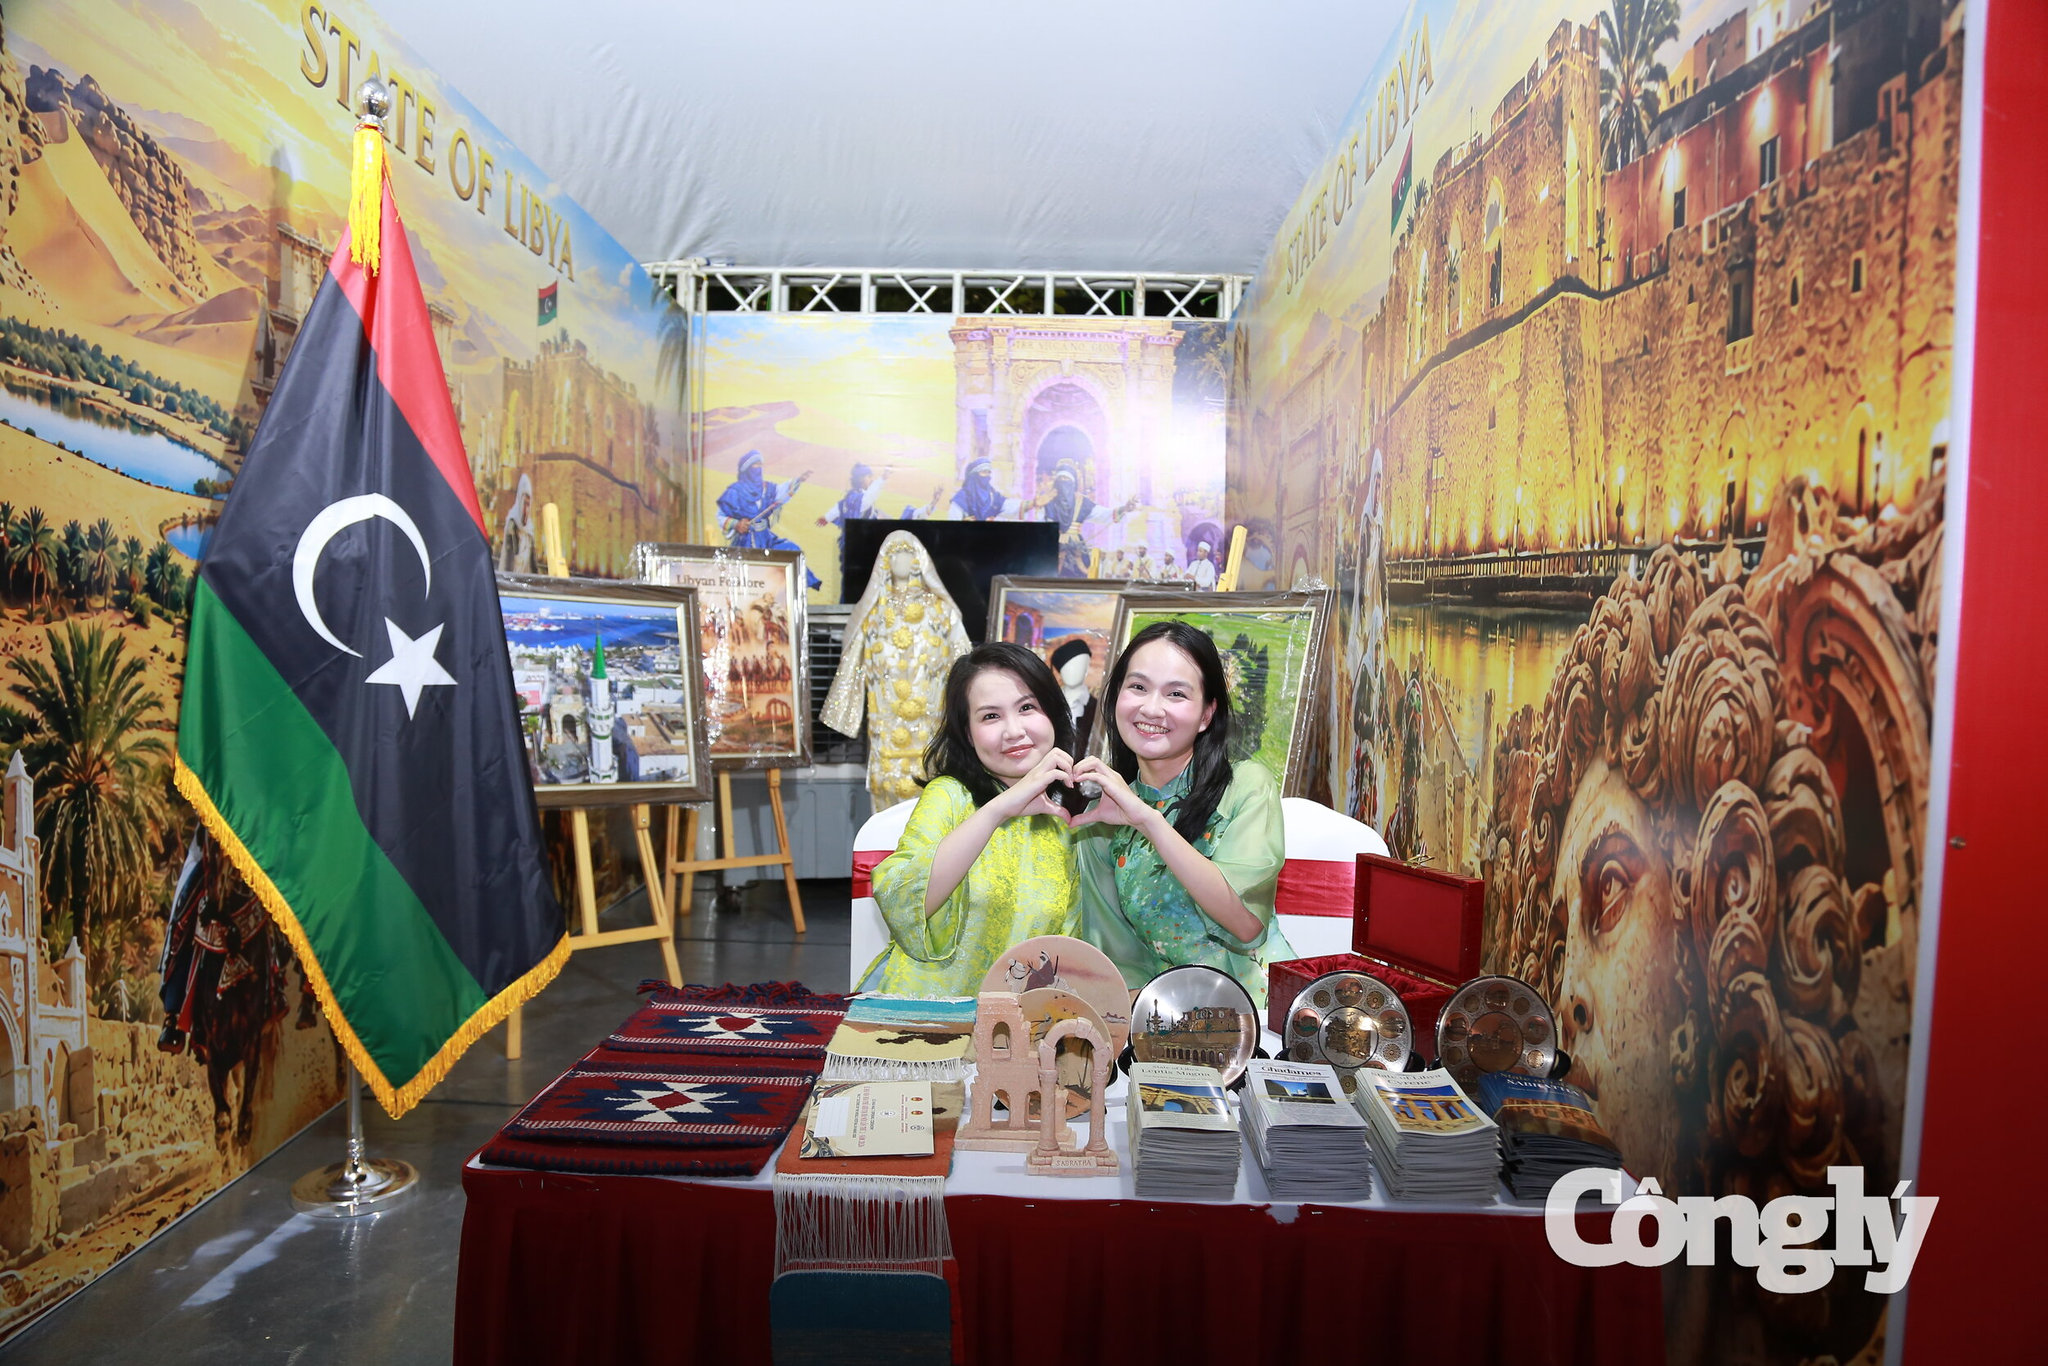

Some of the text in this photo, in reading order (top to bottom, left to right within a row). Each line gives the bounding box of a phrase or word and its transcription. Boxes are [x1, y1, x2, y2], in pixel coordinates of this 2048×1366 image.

[1286, 13, 1434, 295] STATE OF LIBYA
[449, 128, 494, 215] OF
[503, 168, 574, 282] LIBYA
[676, 574, 716, 586] Libyan
[1261, 1065, 1323, 1076] Ghadames
